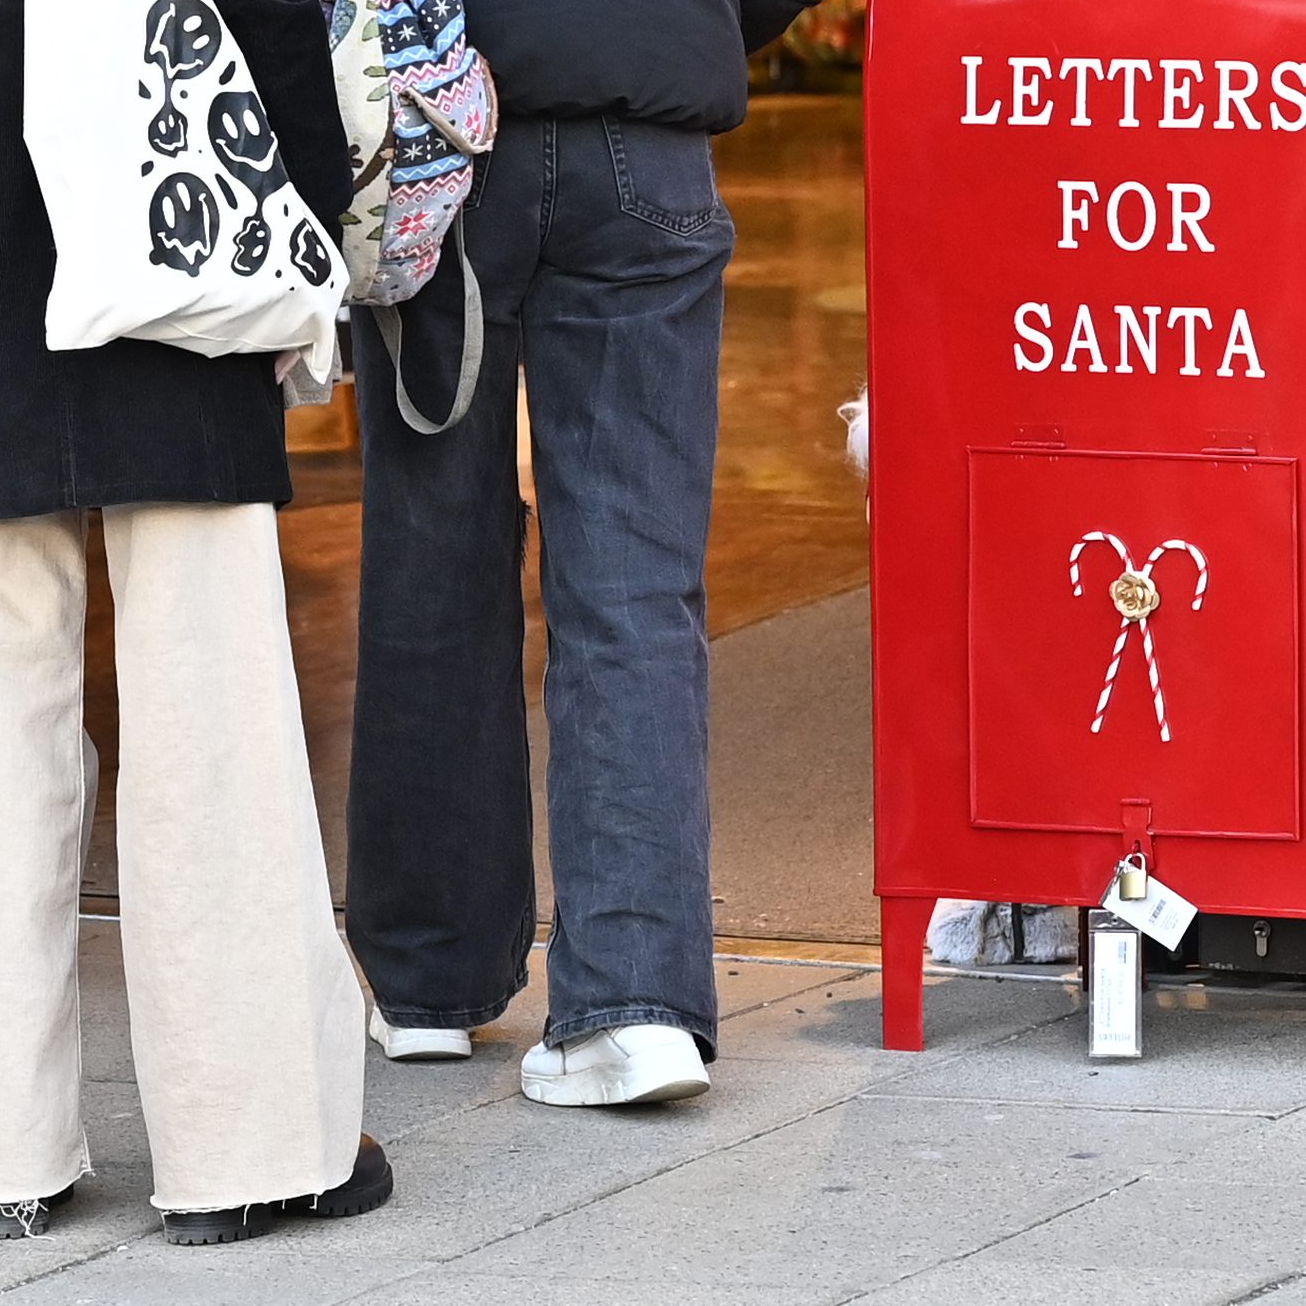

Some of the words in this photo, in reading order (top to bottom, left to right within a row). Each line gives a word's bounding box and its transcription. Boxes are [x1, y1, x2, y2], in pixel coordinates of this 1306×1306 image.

[960, 56, 1306, 132] LETTERS
[1057, 180, 1215, 253] FOR
[1013, 302, 1266, 378] SANTA
